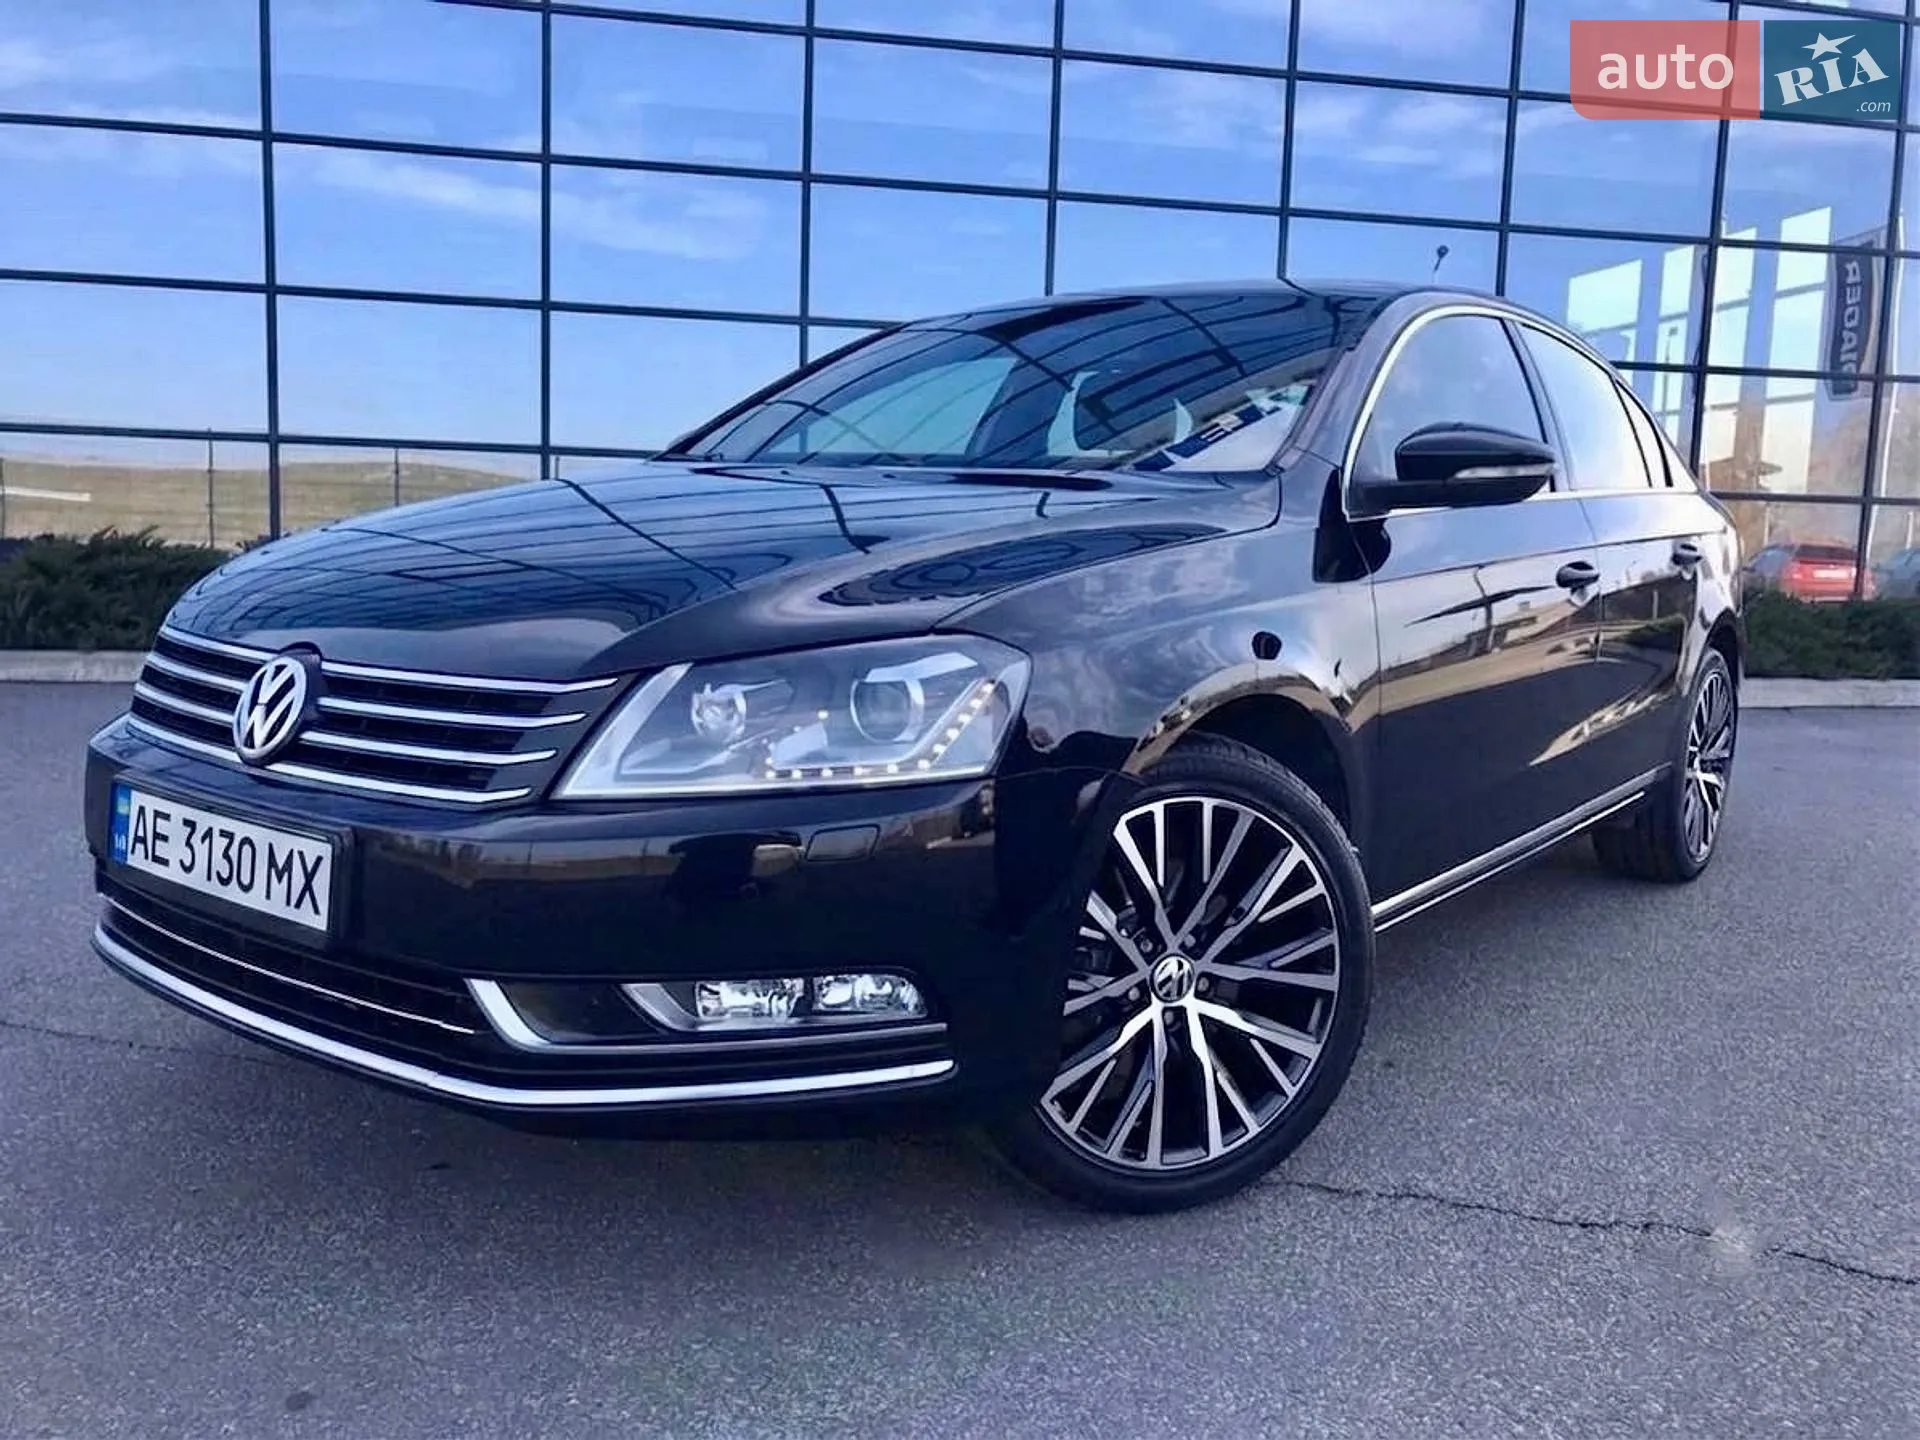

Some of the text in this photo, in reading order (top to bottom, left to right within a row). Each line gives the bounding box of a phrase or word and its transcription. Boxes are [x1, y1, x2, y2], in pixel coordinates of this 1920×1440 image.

[130, 804, 324, 916] AE 3130 MX
